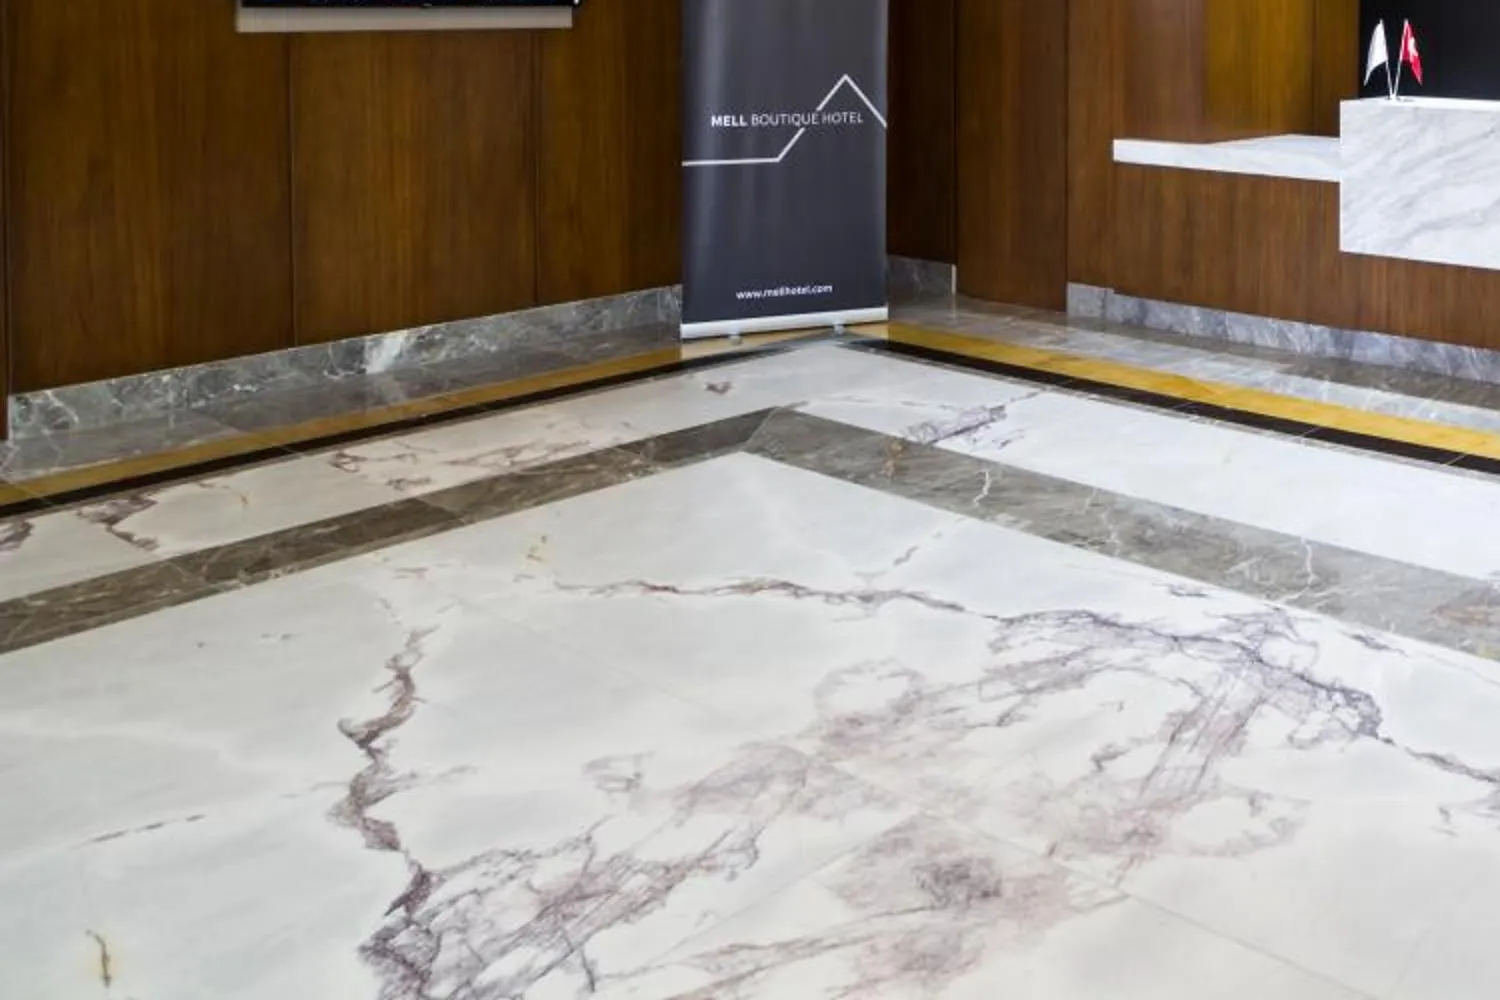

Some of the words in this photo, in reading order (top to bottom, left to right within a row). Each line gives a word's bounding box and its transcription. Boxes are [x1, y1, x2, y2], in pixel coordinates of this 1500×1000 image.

[711, 114, 748, 127] MELL
[751, 111, 819, 127] BOUTIQUE
[821, 111, 864, 125] HOTEL
